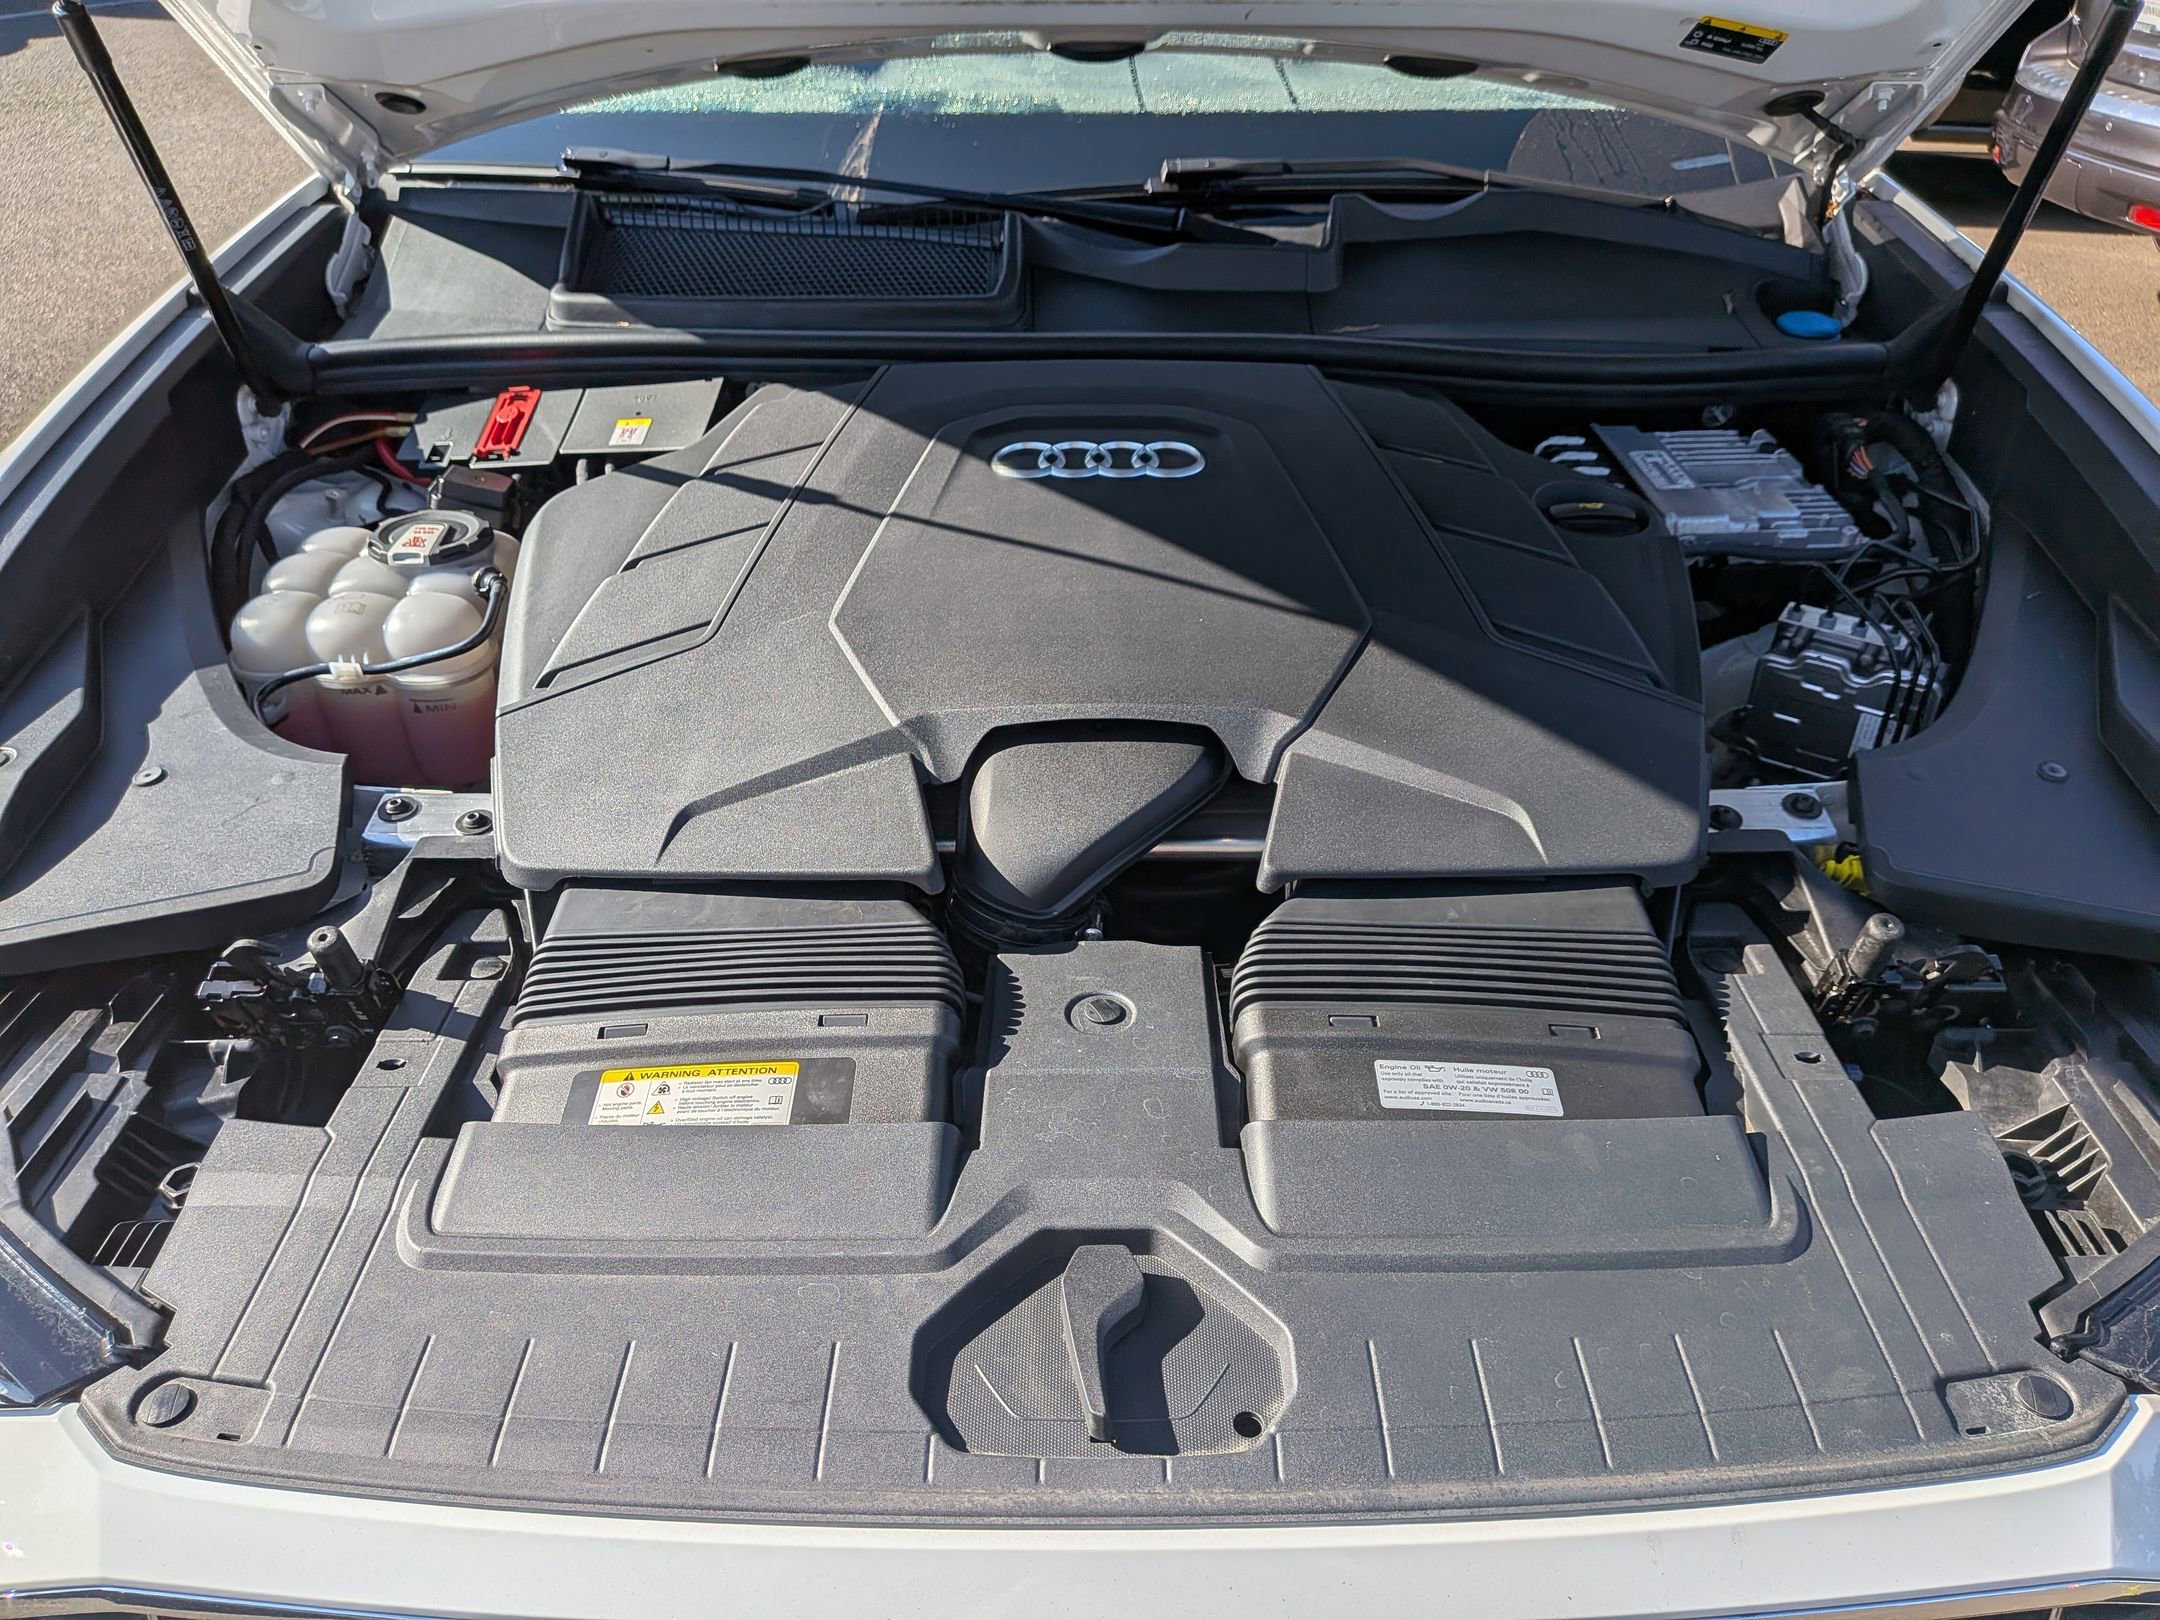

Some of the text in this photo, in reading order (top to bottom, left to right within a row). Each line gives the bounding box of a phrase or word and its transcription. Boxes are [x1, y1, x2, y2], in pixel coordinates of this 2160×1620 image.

[426, 703, 456, 713] MIN
[640, 1067, 778, 1079] WARNING ATTENTION
